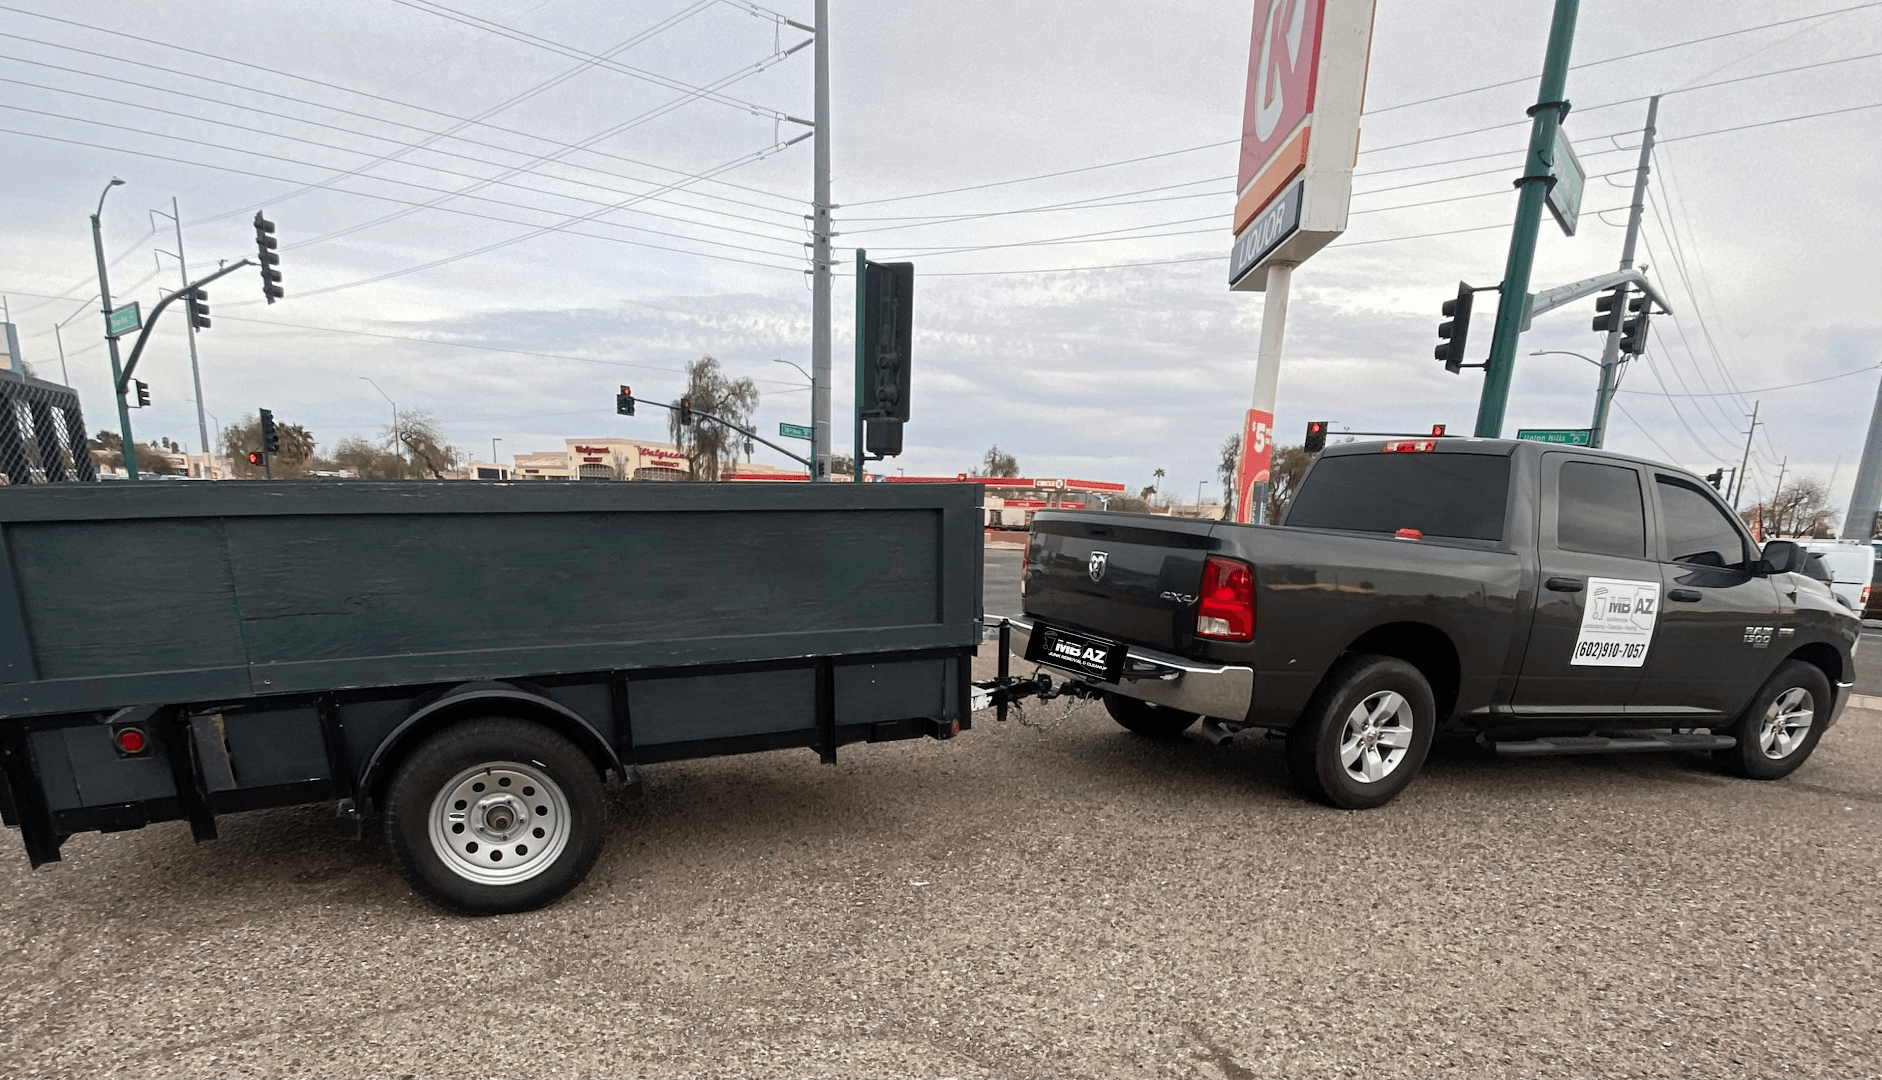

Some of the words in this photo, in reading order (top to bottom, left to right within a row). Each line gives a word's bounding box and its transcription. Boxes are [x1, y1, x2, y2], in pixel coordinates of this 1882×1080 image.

[1238, 201, 1286, 270] LIQUOR
[1548, 434, 1566, 442] Hills
[1056, 479, 1064, 489] K
[1608, 597, 1631, 614] MB
[1634, 598, 1655, 615] AZ
[1743, 635, 1771, 643] 1500
[1574, 641, 1646, 660] (602)910-7057
